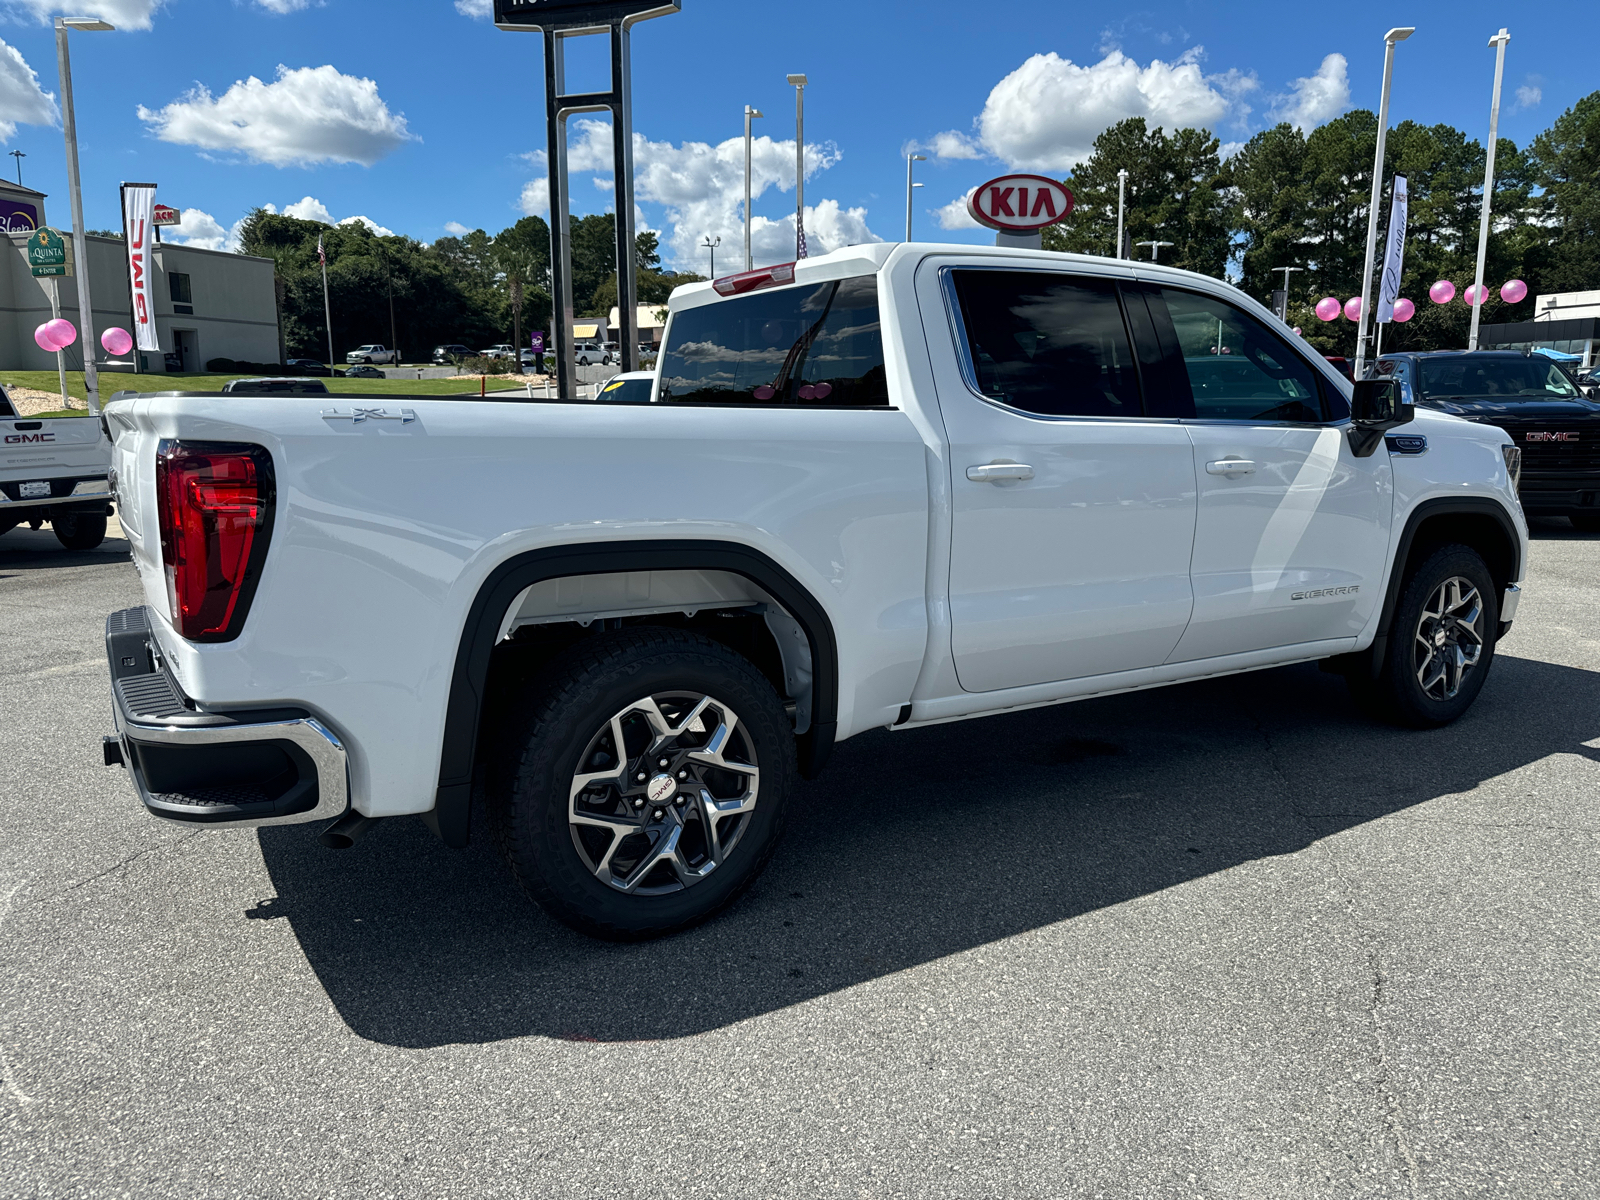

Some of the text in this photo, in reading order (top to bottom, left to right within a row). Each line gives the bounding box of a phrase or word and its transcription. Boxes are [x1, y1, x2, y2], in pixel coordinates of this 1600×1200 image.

[990, 187, 1057, 217] KIA
[35, 247, 63, 259] QUINTA
[131, 219, 149, 325] GMC
[4, 433, 56, 444] GMC
[1526, 431, 1580, 442] GMC
[1290, 585, 1360, 601] SIERRA
[651, 778, 673, 800] GMC
